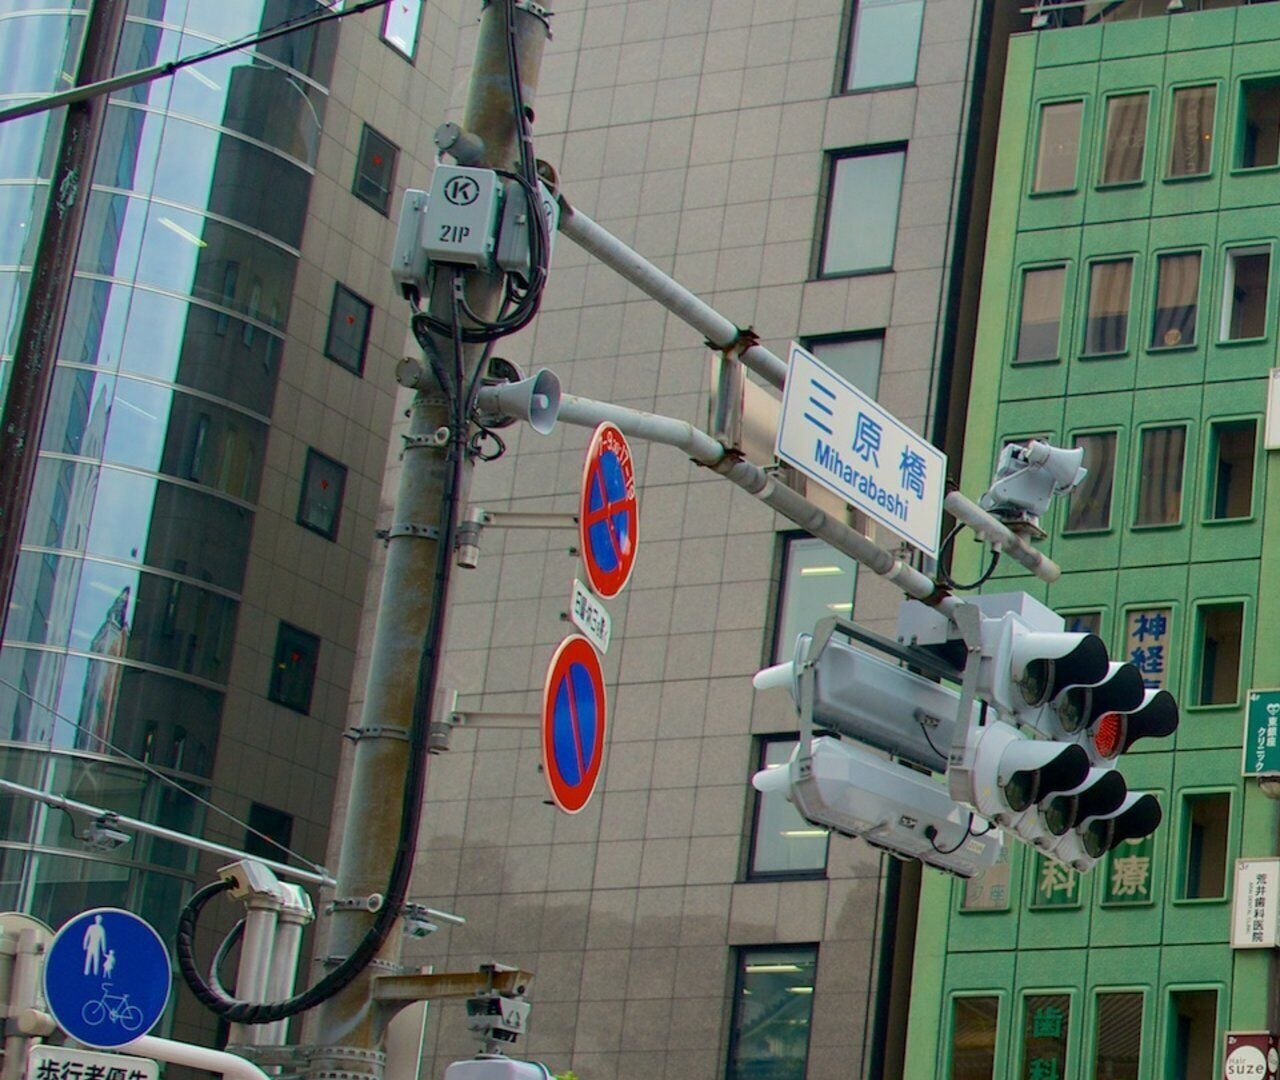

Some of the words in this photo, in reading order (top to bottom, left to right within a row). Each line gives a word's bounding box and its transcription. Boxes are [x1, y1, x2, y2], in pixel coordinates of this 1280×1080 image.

[804, 378, 927, 501] 三原橋
[814, 438, 910, 523] Miharabashi
[1255, 726, 1266, 772] クリニック
[1228, 1064, 1264, 1075] suze
